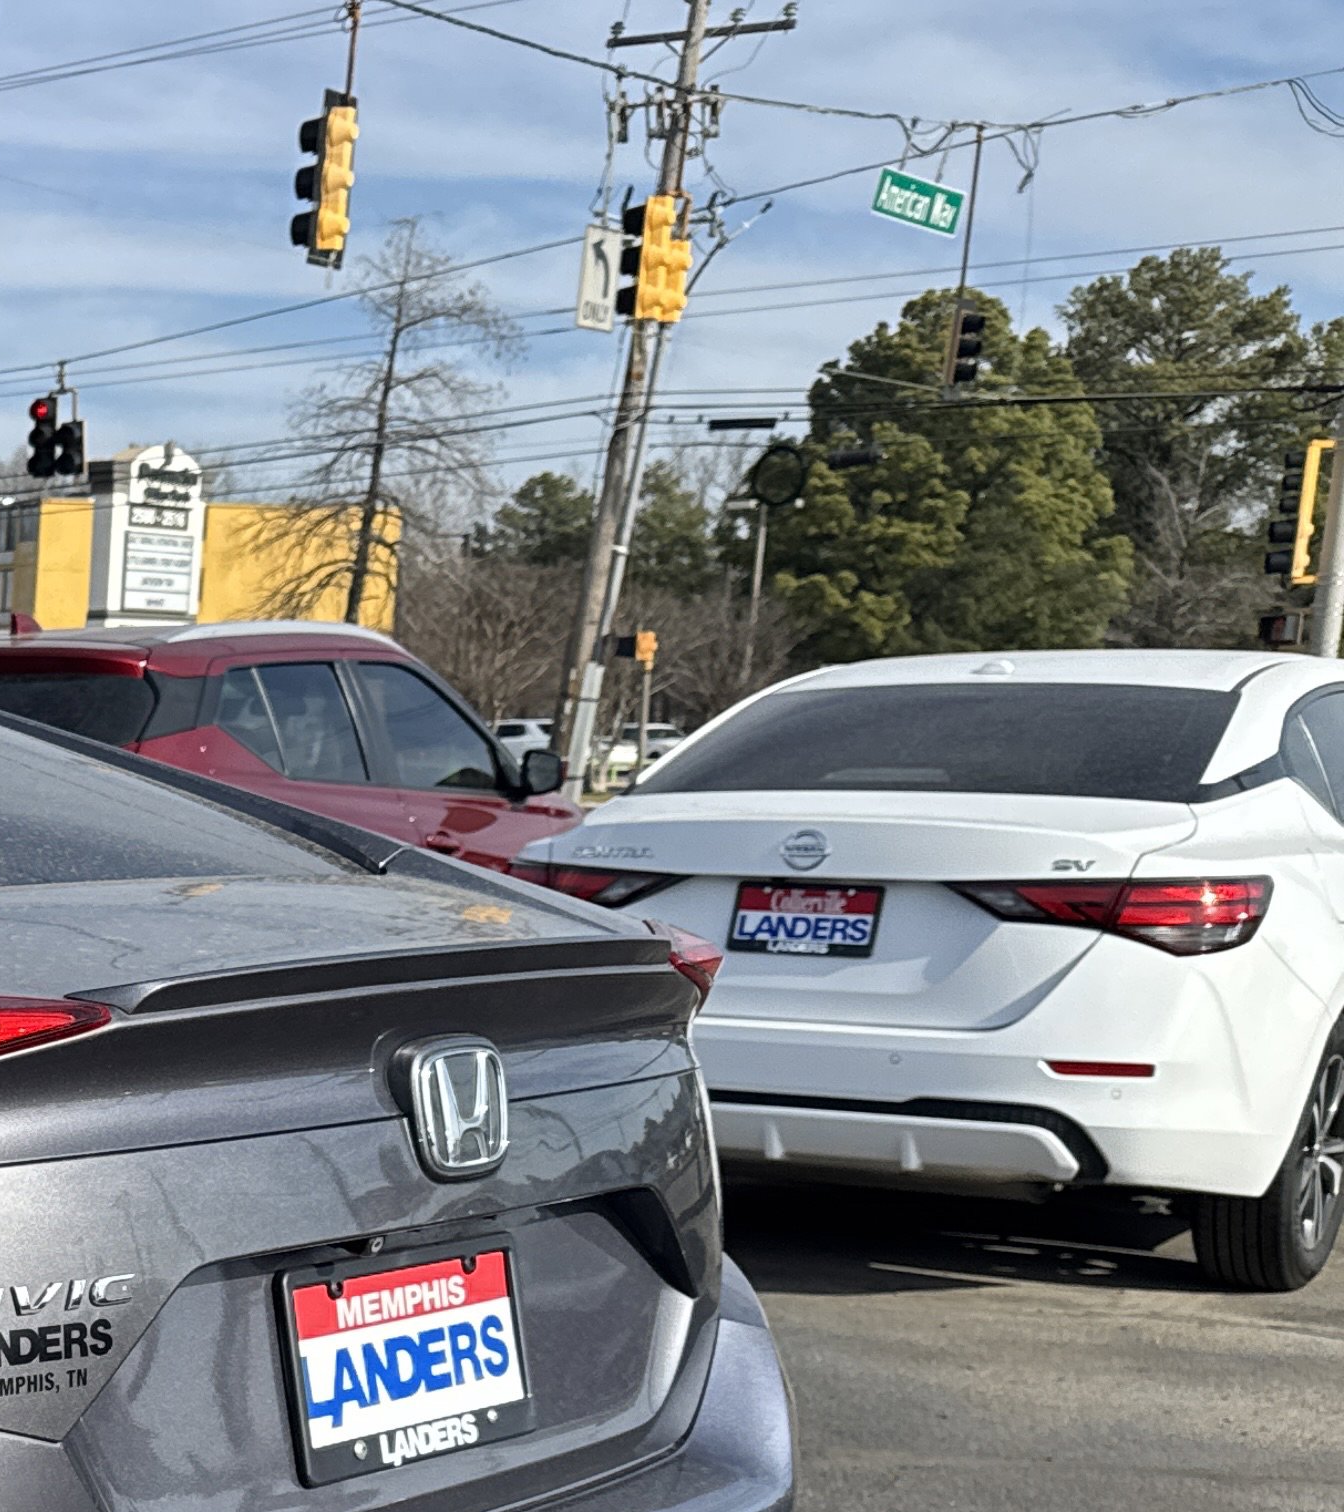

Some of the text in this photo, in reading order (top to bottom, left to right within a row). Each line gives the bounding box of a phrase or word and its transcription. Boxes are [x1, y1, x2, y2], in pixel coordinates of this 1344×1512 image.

[877, 175, 931, 222] American
[1051, 859, 1097, 872] SV
[736, 914, 870, 942] LANDERS
[335, 1275, 467, 1330] MEMPHIS
[66, 1368, 88, 1388] TN
[300, 1315, 510, 1429] LANDERS
[379, 1413, 479, 1467] LANDERS
